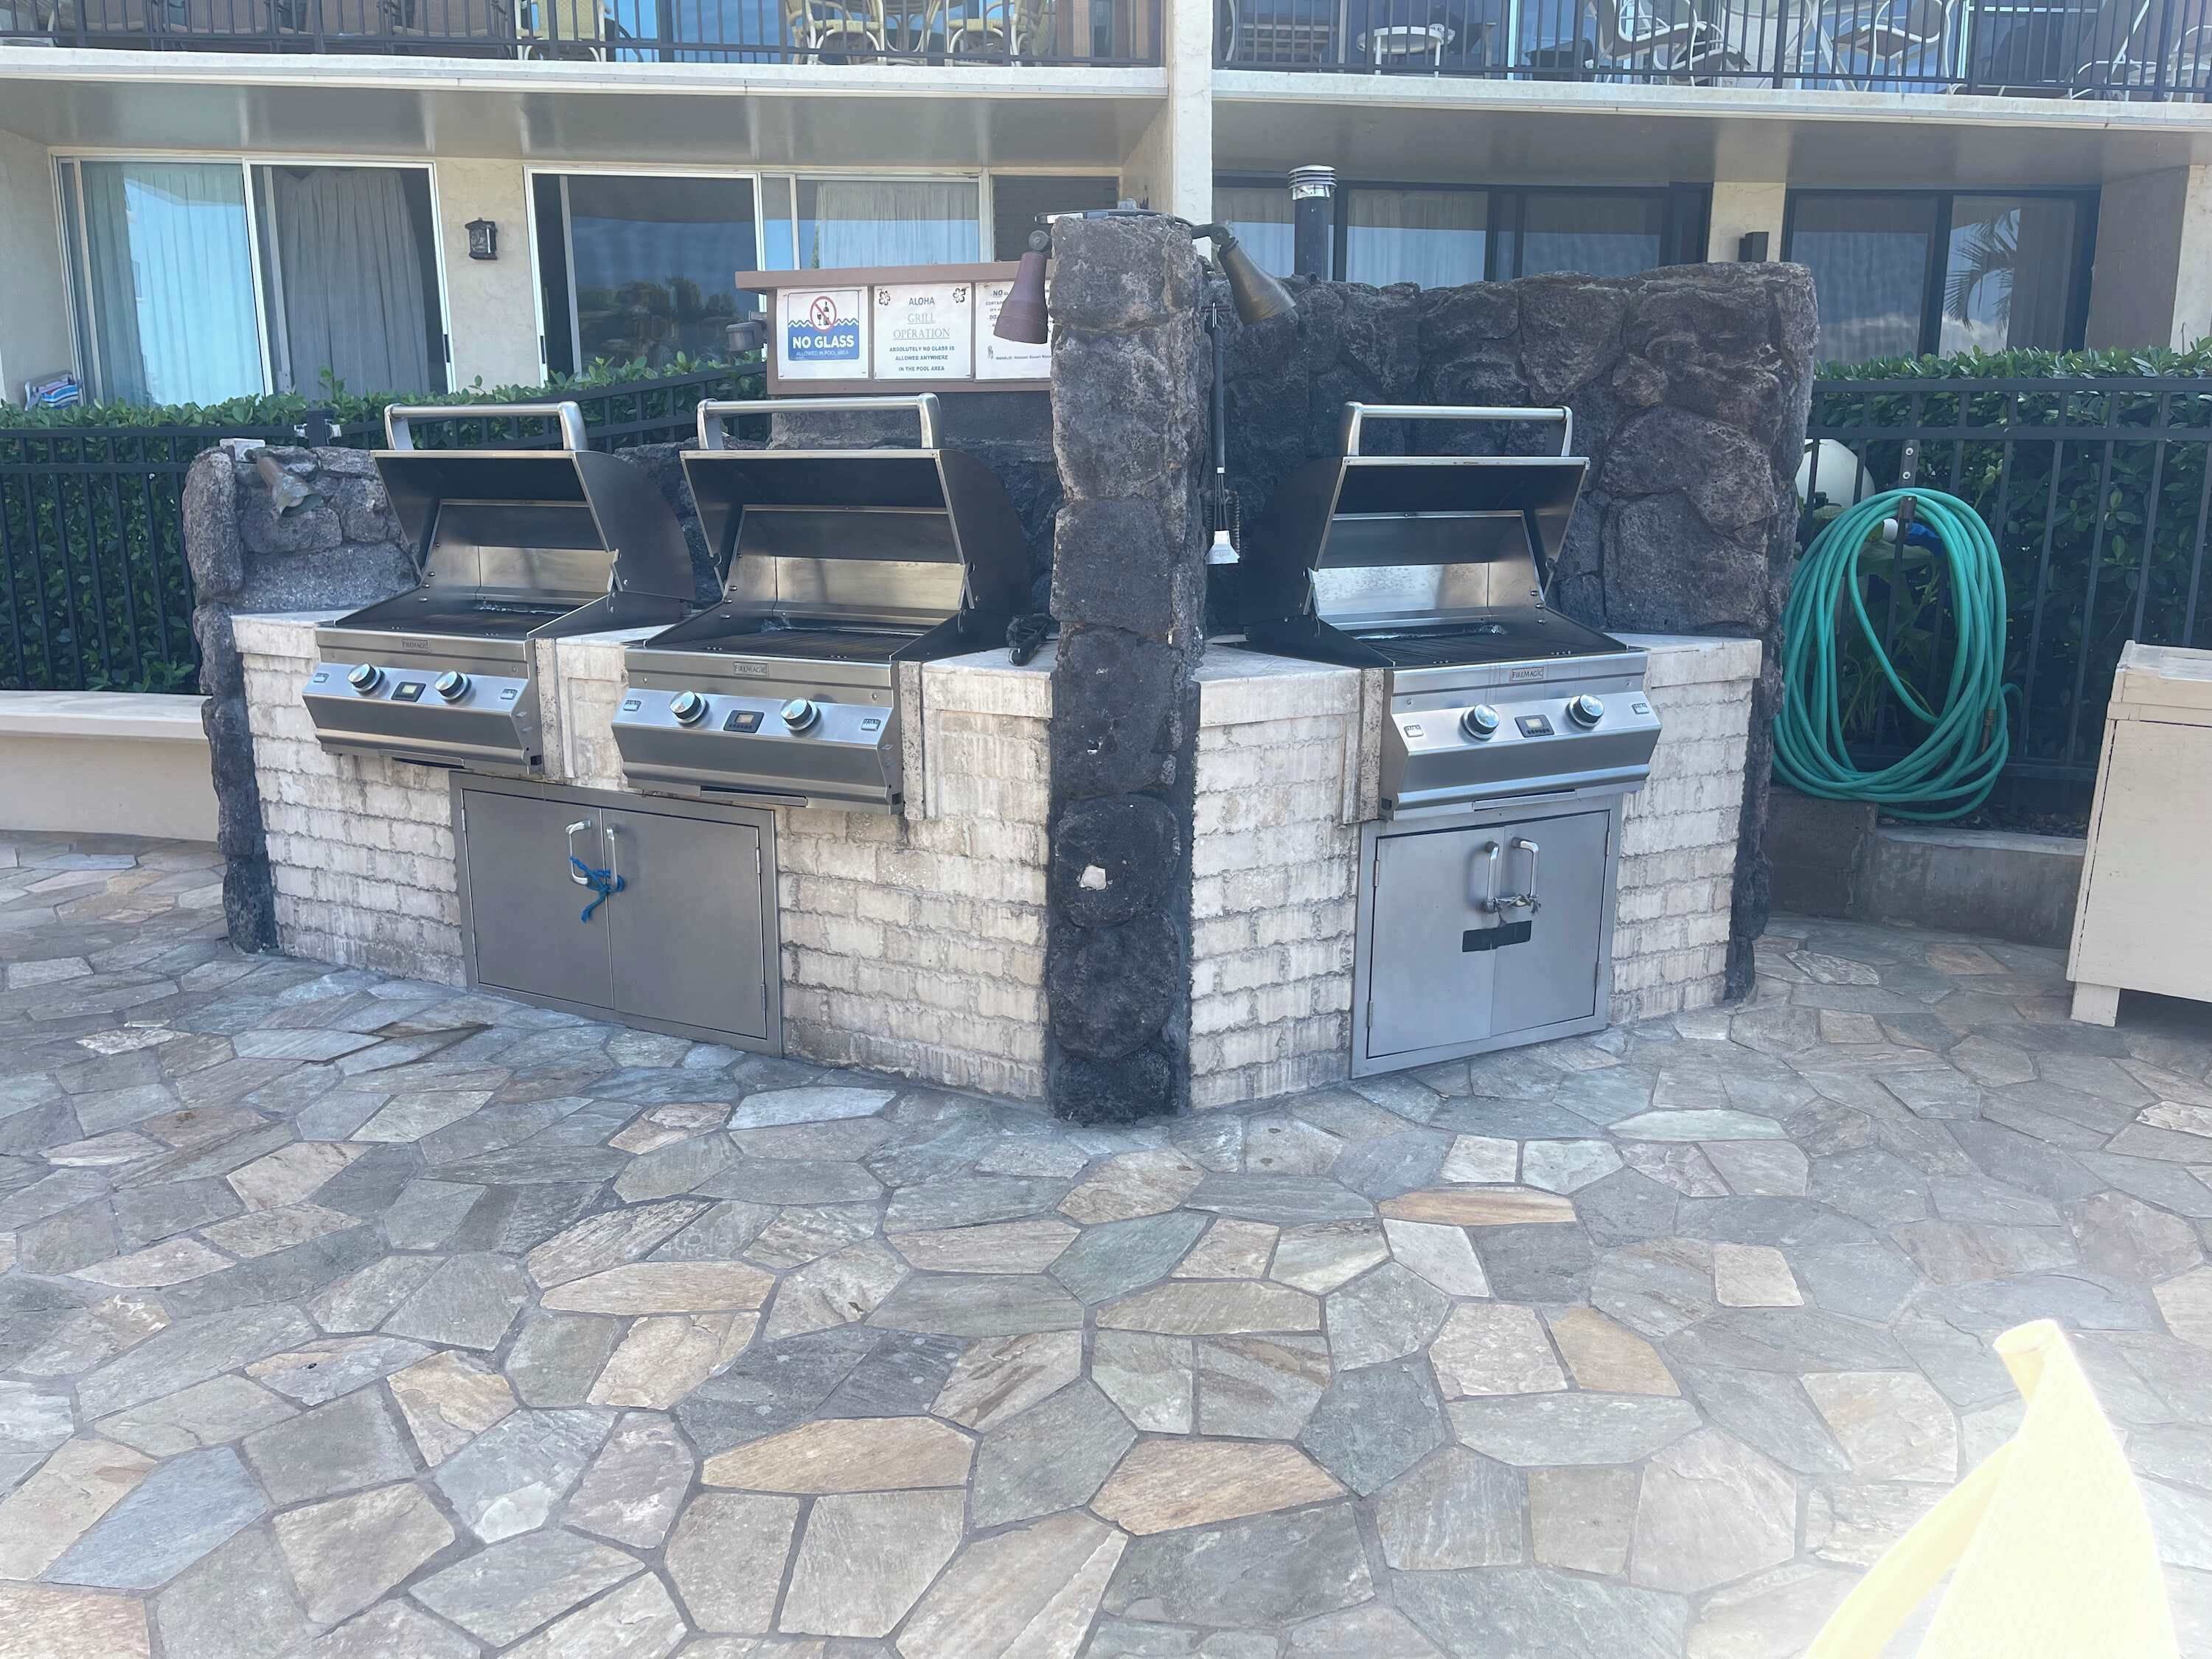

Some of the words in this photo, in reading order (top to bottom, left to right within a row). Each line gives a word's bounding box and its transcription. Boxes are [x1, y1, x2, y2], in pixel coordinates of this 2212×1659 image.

[909, 297, 935, 305] ALOHA
[908, 313, 935, 323] GRILL
[893, 327, 950, 338] OPERATION
[793, 336, 811, 349] NO
[814, 335, 855, 348] GLASS
